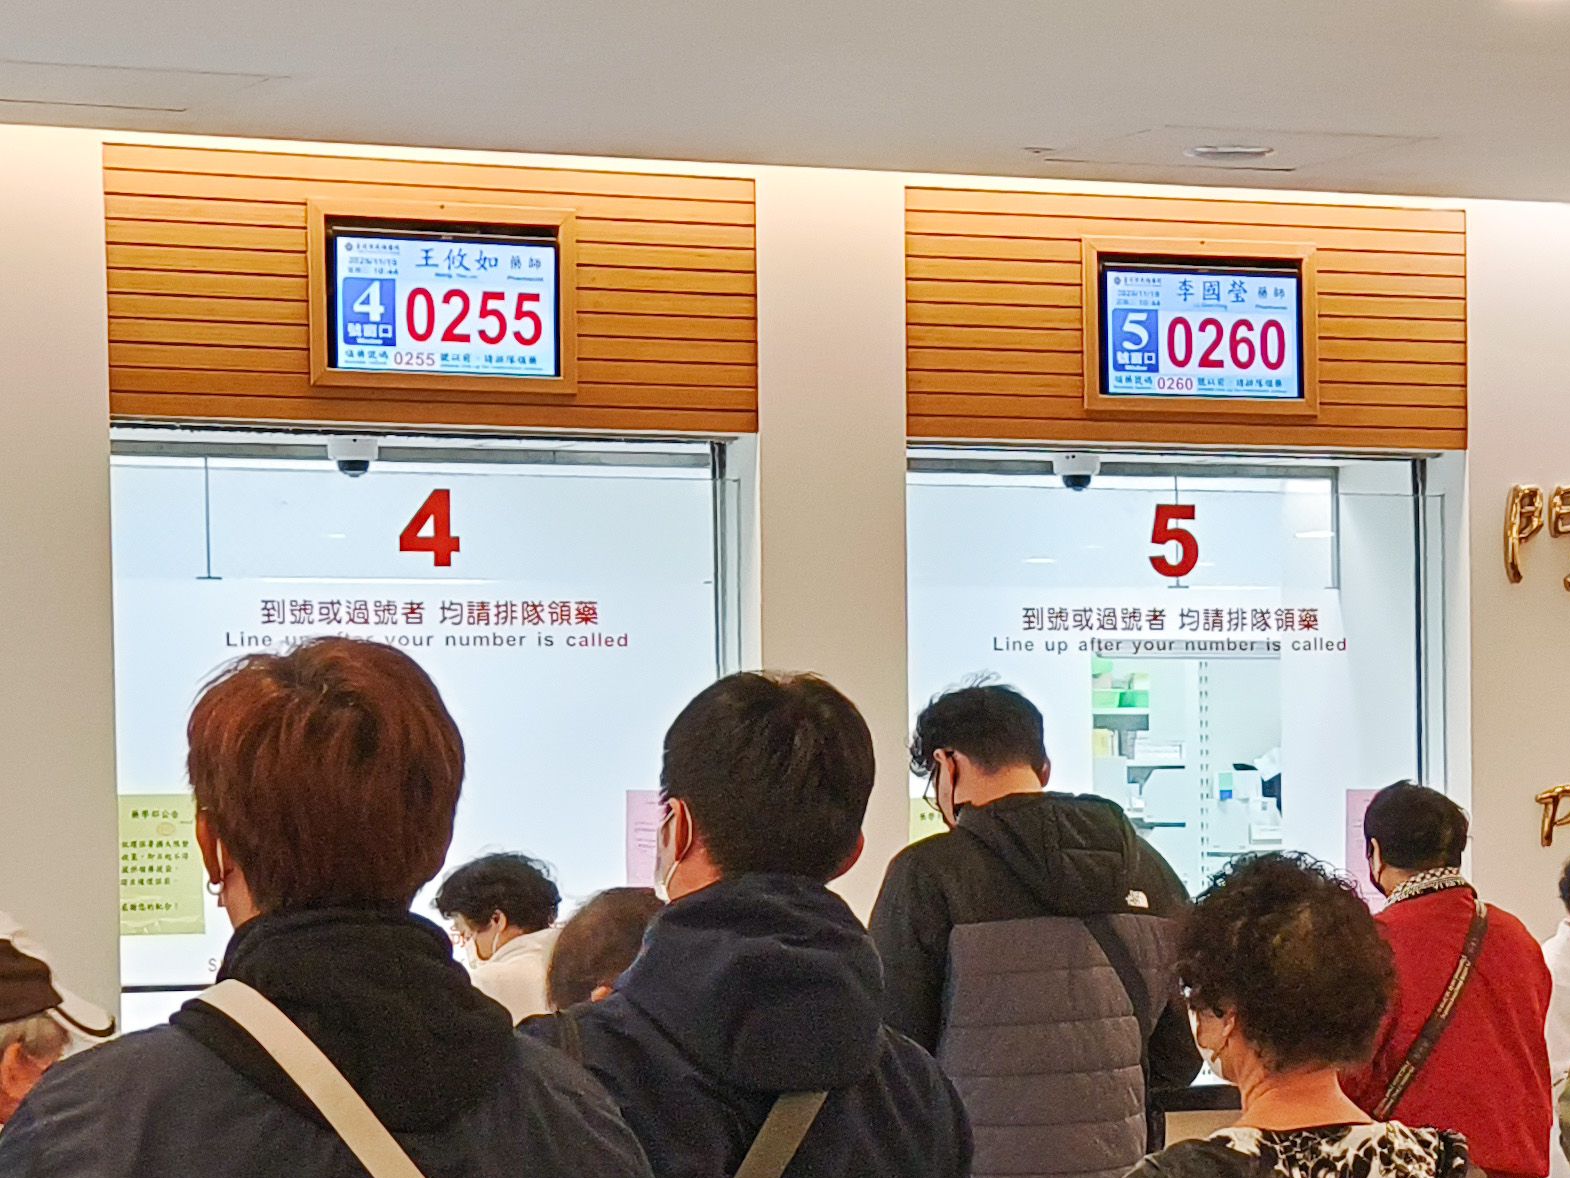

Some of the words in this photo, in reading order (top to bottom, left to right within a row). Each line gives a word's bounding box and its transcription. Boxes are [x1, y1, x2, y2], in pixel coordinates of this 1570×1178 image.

[353, 280, 385, 322] 4
[406, 286, 543, 346] 0255
[1122, 312, 1149, 350] 5
[1167, 316, 1286, 371] 0260
[394, 351, 436, 367] 0255
[1157, 376, 1194, 391] 0260
[400, 488, 460, 567] 4
[1148, 503, 1199, 578] 5
[261, 599, 425, 626] 到號或過號者
[440, 600, 599, 626] 均請排隊領藥
[1022, 607, 1166, 632] 到號或過號者
[1179, 607, 1319, 632] 均請排隊領藥
[226, 632, 272, 648] Line
[384, 634, 434, 648] your
[445, 631, 526, 648] number
[537, 632, 554, 648] is
[569, 632, 628, 648] called
[993, 636, 1034, 652] Line
[1045, 639, 1068, 655] up
[1079, 636, 1122, 652] after
[1132, 639, 1174, 655] your
[1185, 637, 1256, 652] number
[1266, 637, 1280, 652] is
[1291, 636, 1347, 652] called
